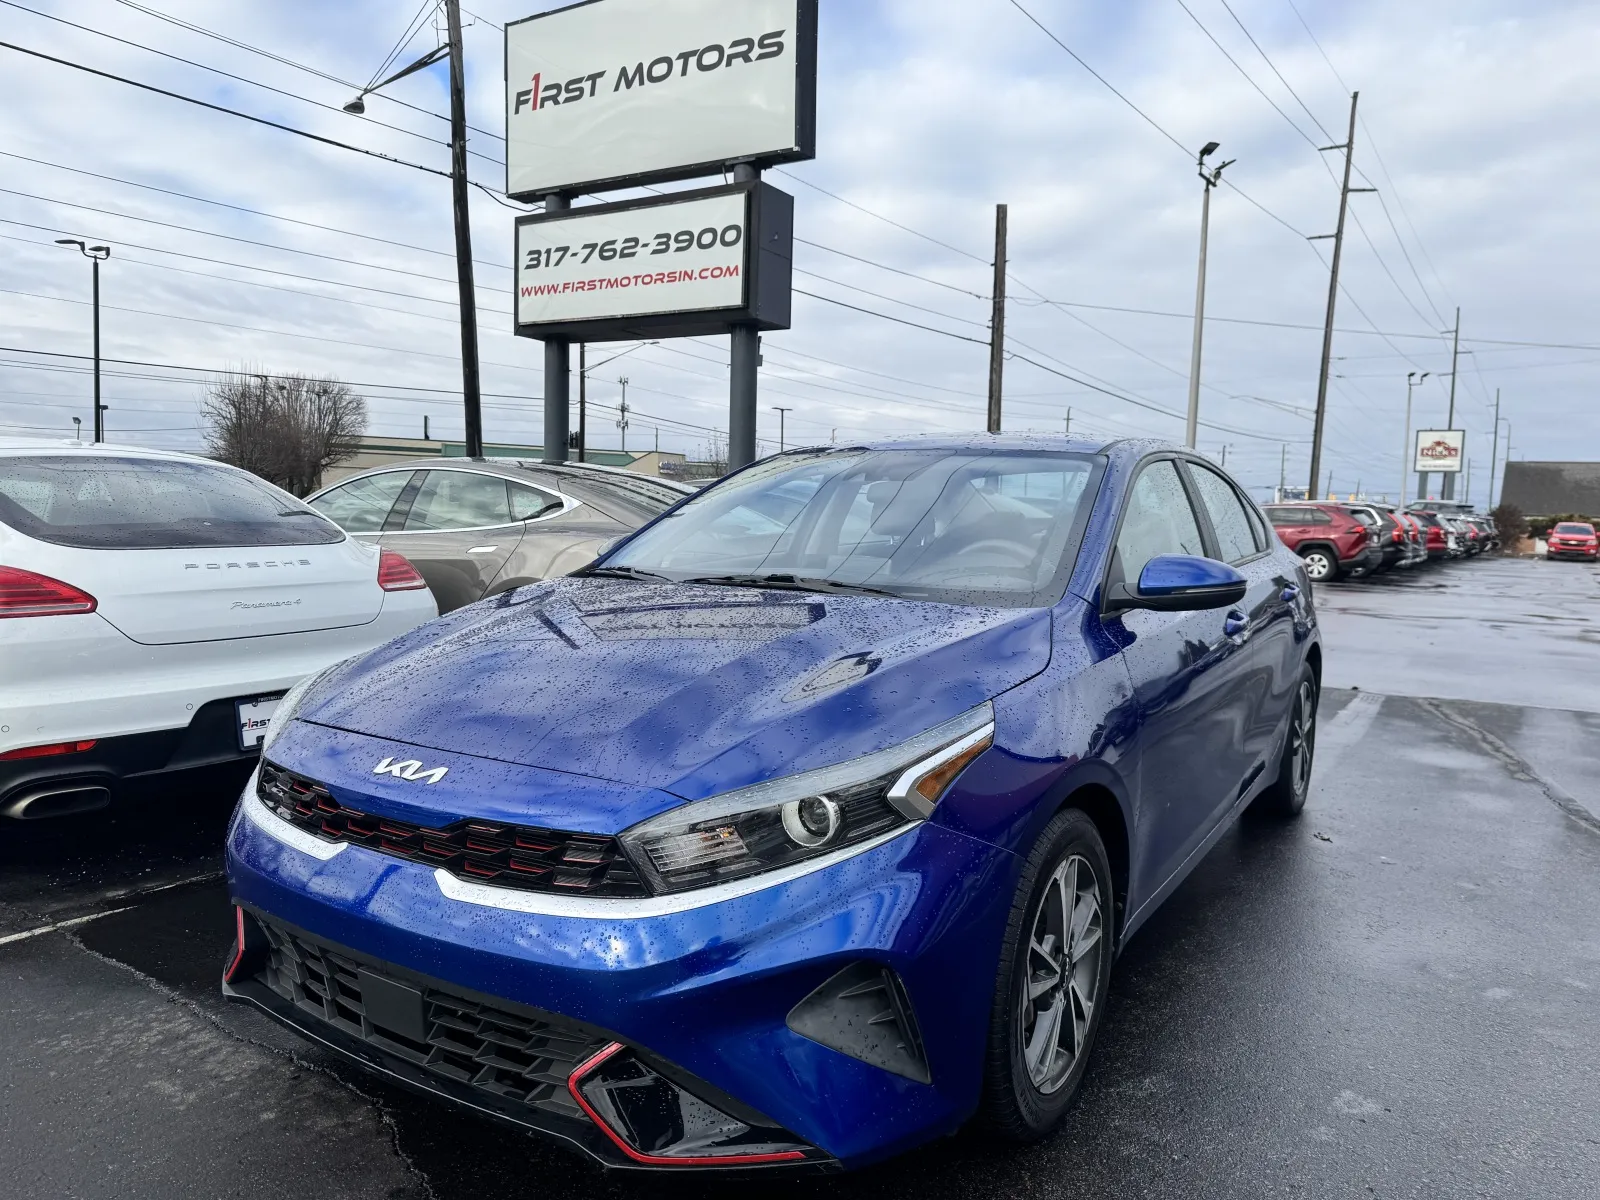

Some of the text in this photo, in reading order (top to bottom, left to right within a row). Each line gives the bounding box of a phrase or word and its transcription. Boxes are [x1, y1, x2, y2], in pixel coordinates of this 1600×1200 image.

[613, 29, 786, 92] MOTORS
[524, 224, 742, 270] 317-762-3900
[521, 265, 739, 298] WWW.FIRSTMOTORSIN.COM
[184, 559, 311, 570] PORSCHE
[230, 598, 302, 610] Panamera 4
[373, 757, 449, 784] KIA
